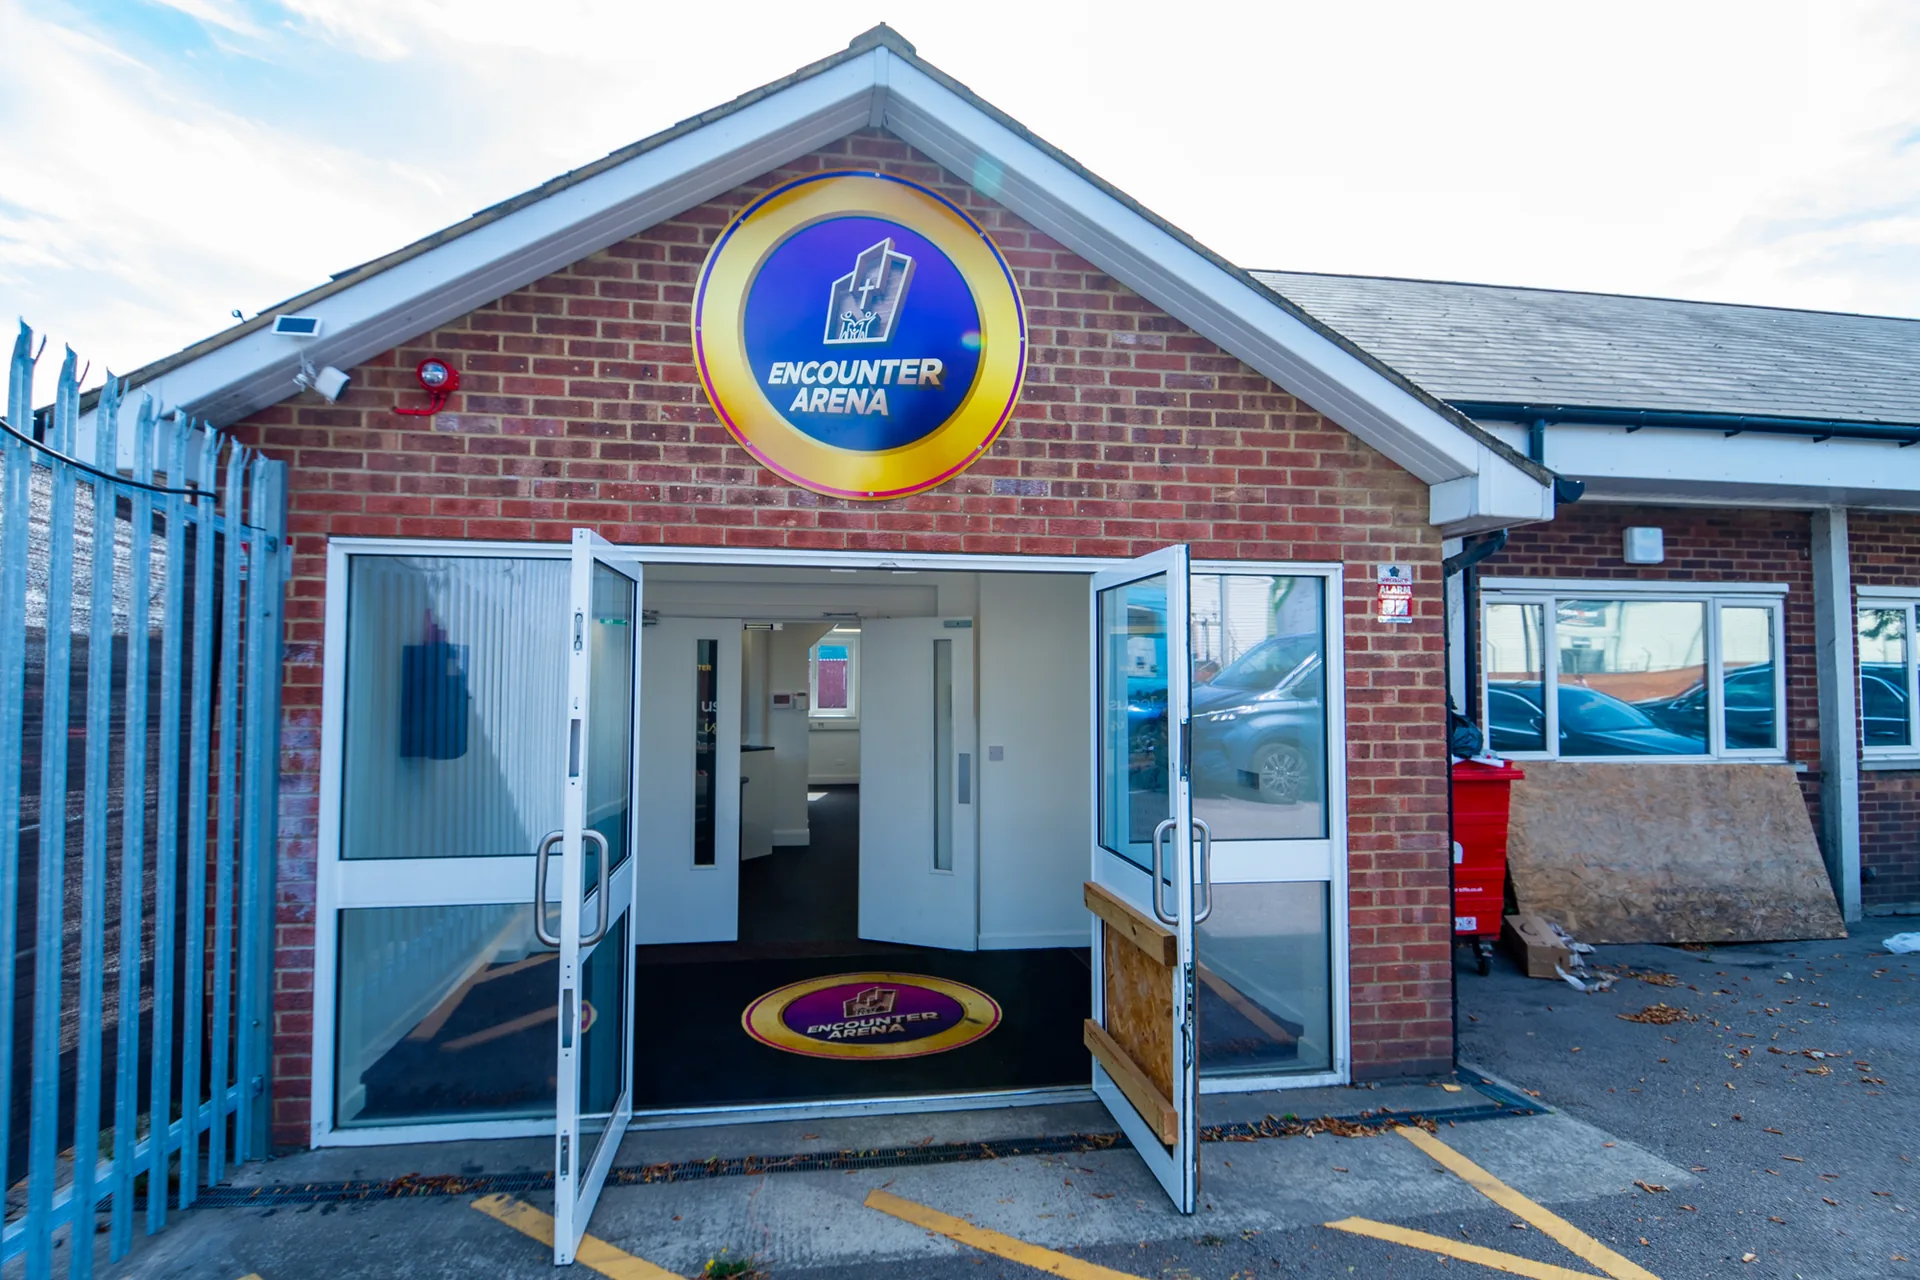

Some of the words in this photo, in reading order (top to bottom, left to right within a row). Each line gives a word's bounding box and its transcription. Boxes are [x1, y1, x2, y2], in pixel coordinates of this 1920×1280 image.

[767, 358, 943, 386] ENCOUNTER
[789, 387, 889, 416] ARENA
[1381, 585, 1411, 594] ALARM
[807, 1012, 939, 1033] ENCOUNTER
[828, 1023, 905, 1039] ARENA
